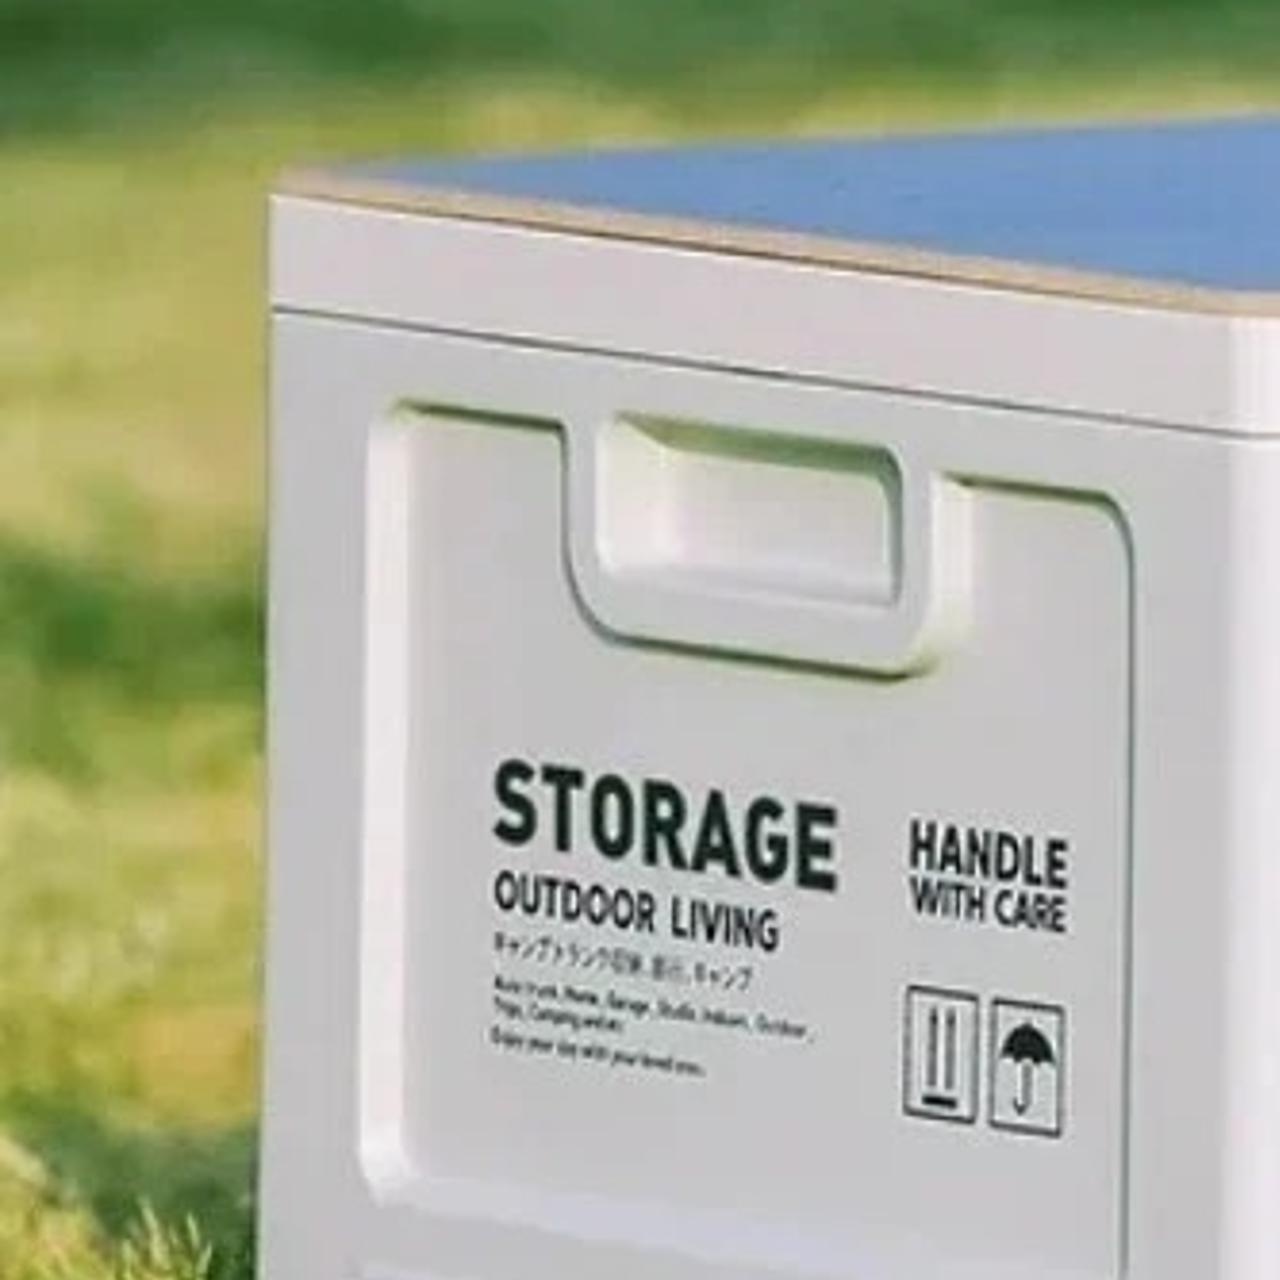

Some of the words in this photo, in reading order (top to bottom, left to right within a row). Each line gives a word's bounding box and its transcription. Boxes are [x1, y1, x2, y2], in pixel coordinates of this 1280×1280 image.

[493, 759, 838, 893] STORAGE
[910, 818, 1068, 889] HANDLE
[494, 870, 656, 933] OUTDOOR
[670, 895, 779, 952] LIVING
[909, 875, 986, 923] WITH
[994, 888, 1067, 934] CARE
